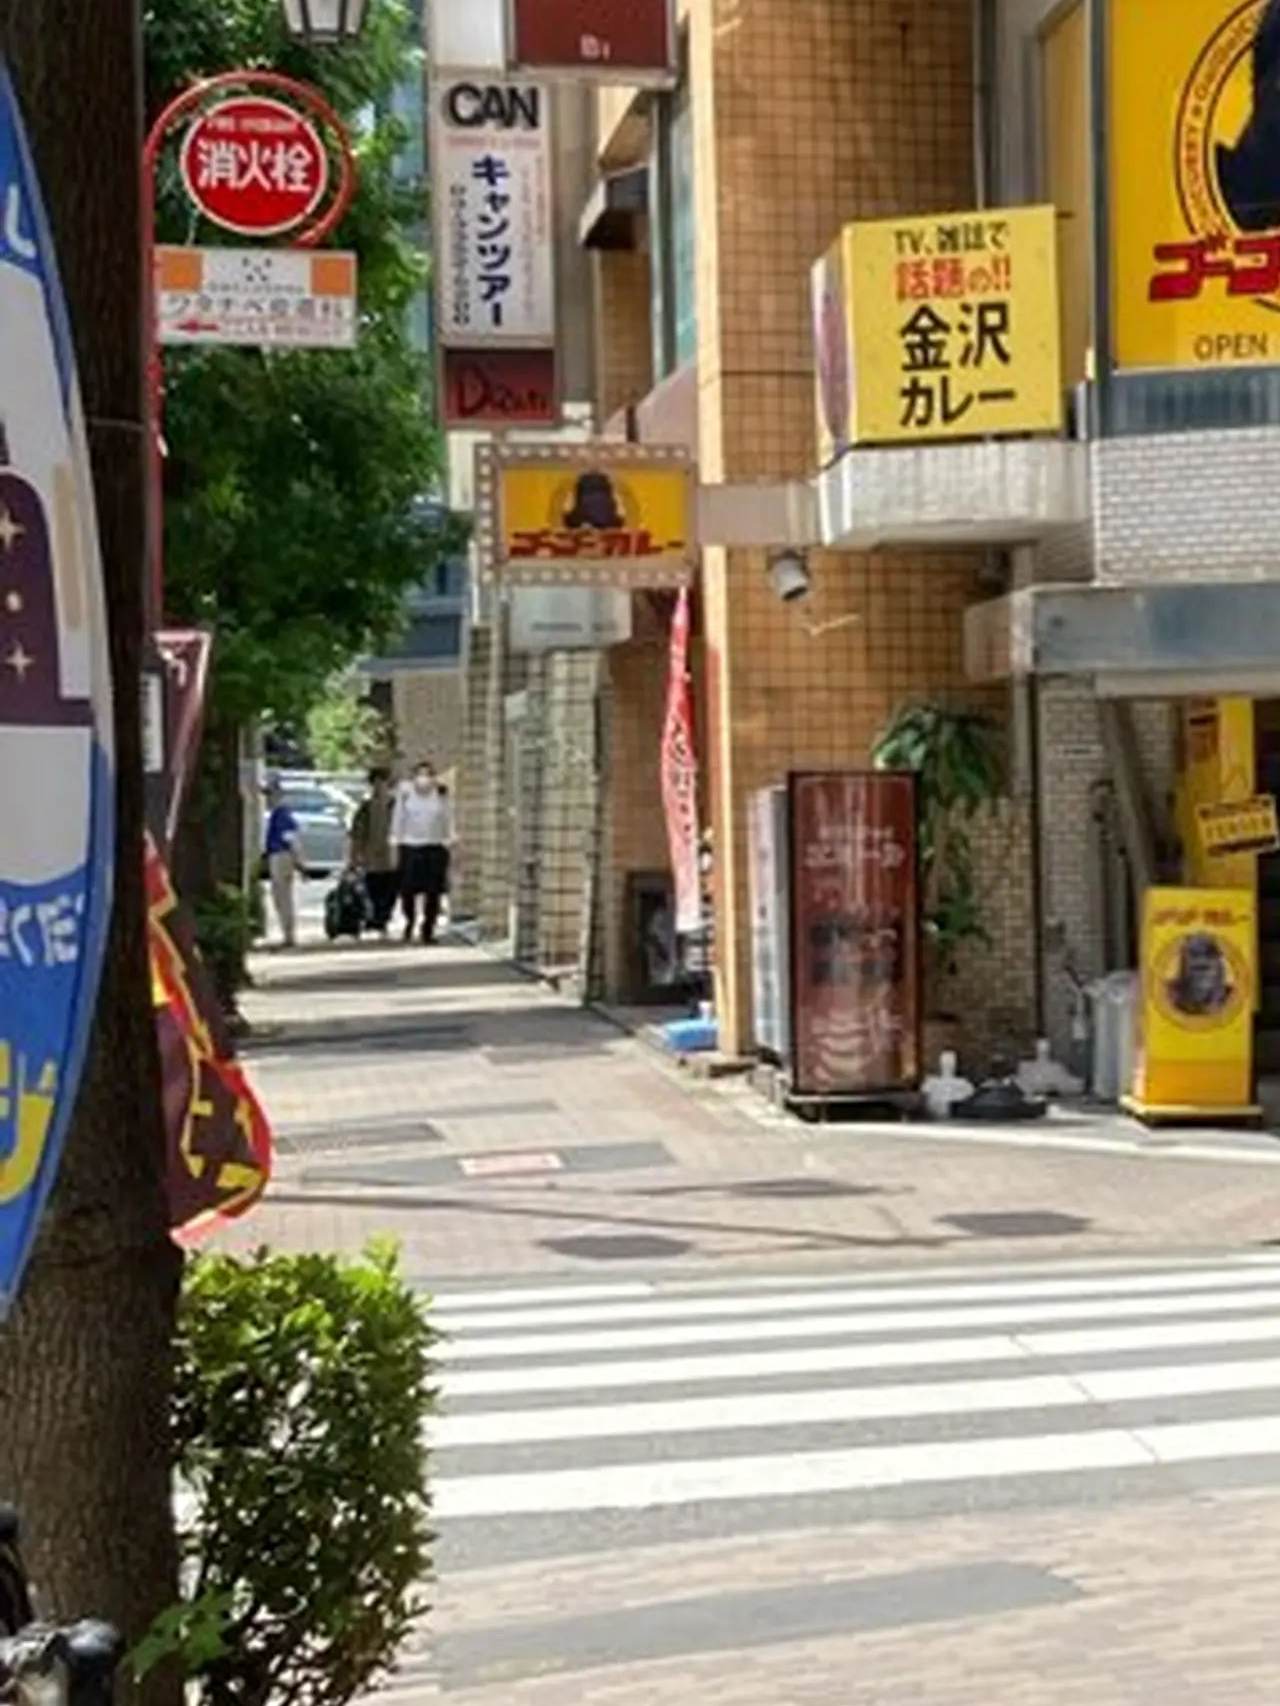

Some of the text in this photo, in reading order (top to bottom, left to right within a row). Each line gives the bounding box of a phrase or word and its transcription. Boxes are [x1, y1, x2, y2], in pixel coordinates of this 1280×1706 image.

[444, 83, 540, 129] CAN
[196, 138, 313, 193] 消火栓
[472, 153, 512, 327] キャンツアー
[899, 302, 1012, 372] 金沢
[1194, 329, 1268, 361] OPEN
[899, 375, 1017, 428] カレー
